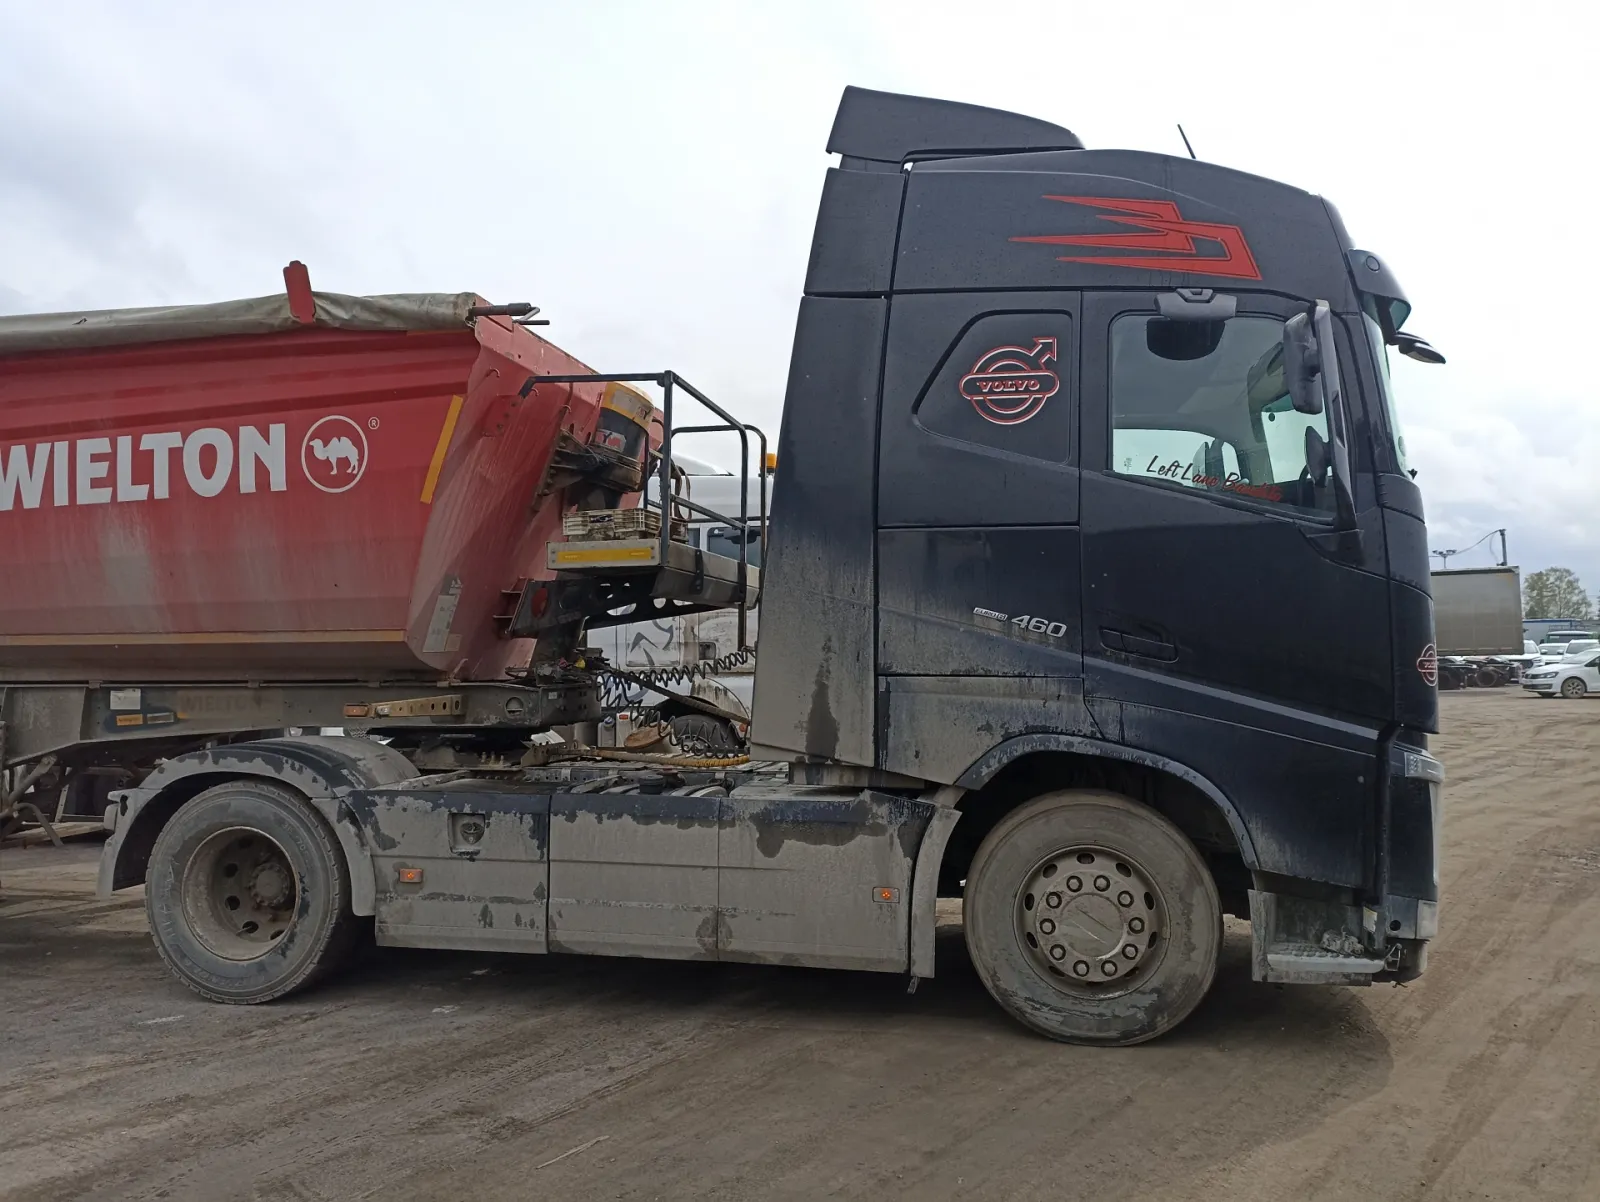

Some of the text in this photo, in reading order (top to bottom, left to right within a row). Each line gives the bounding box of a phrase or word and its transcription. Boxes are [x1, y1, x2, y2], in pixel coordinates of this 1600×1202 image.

[977, 379, 1040, 392] VOLVO
[0, 423, 287, 511] WIELTON
[1146, 455, 1184, 478] Left
[1181, 463, 1219, 487] Lane
[1011, 615, 1067, 638] 460
